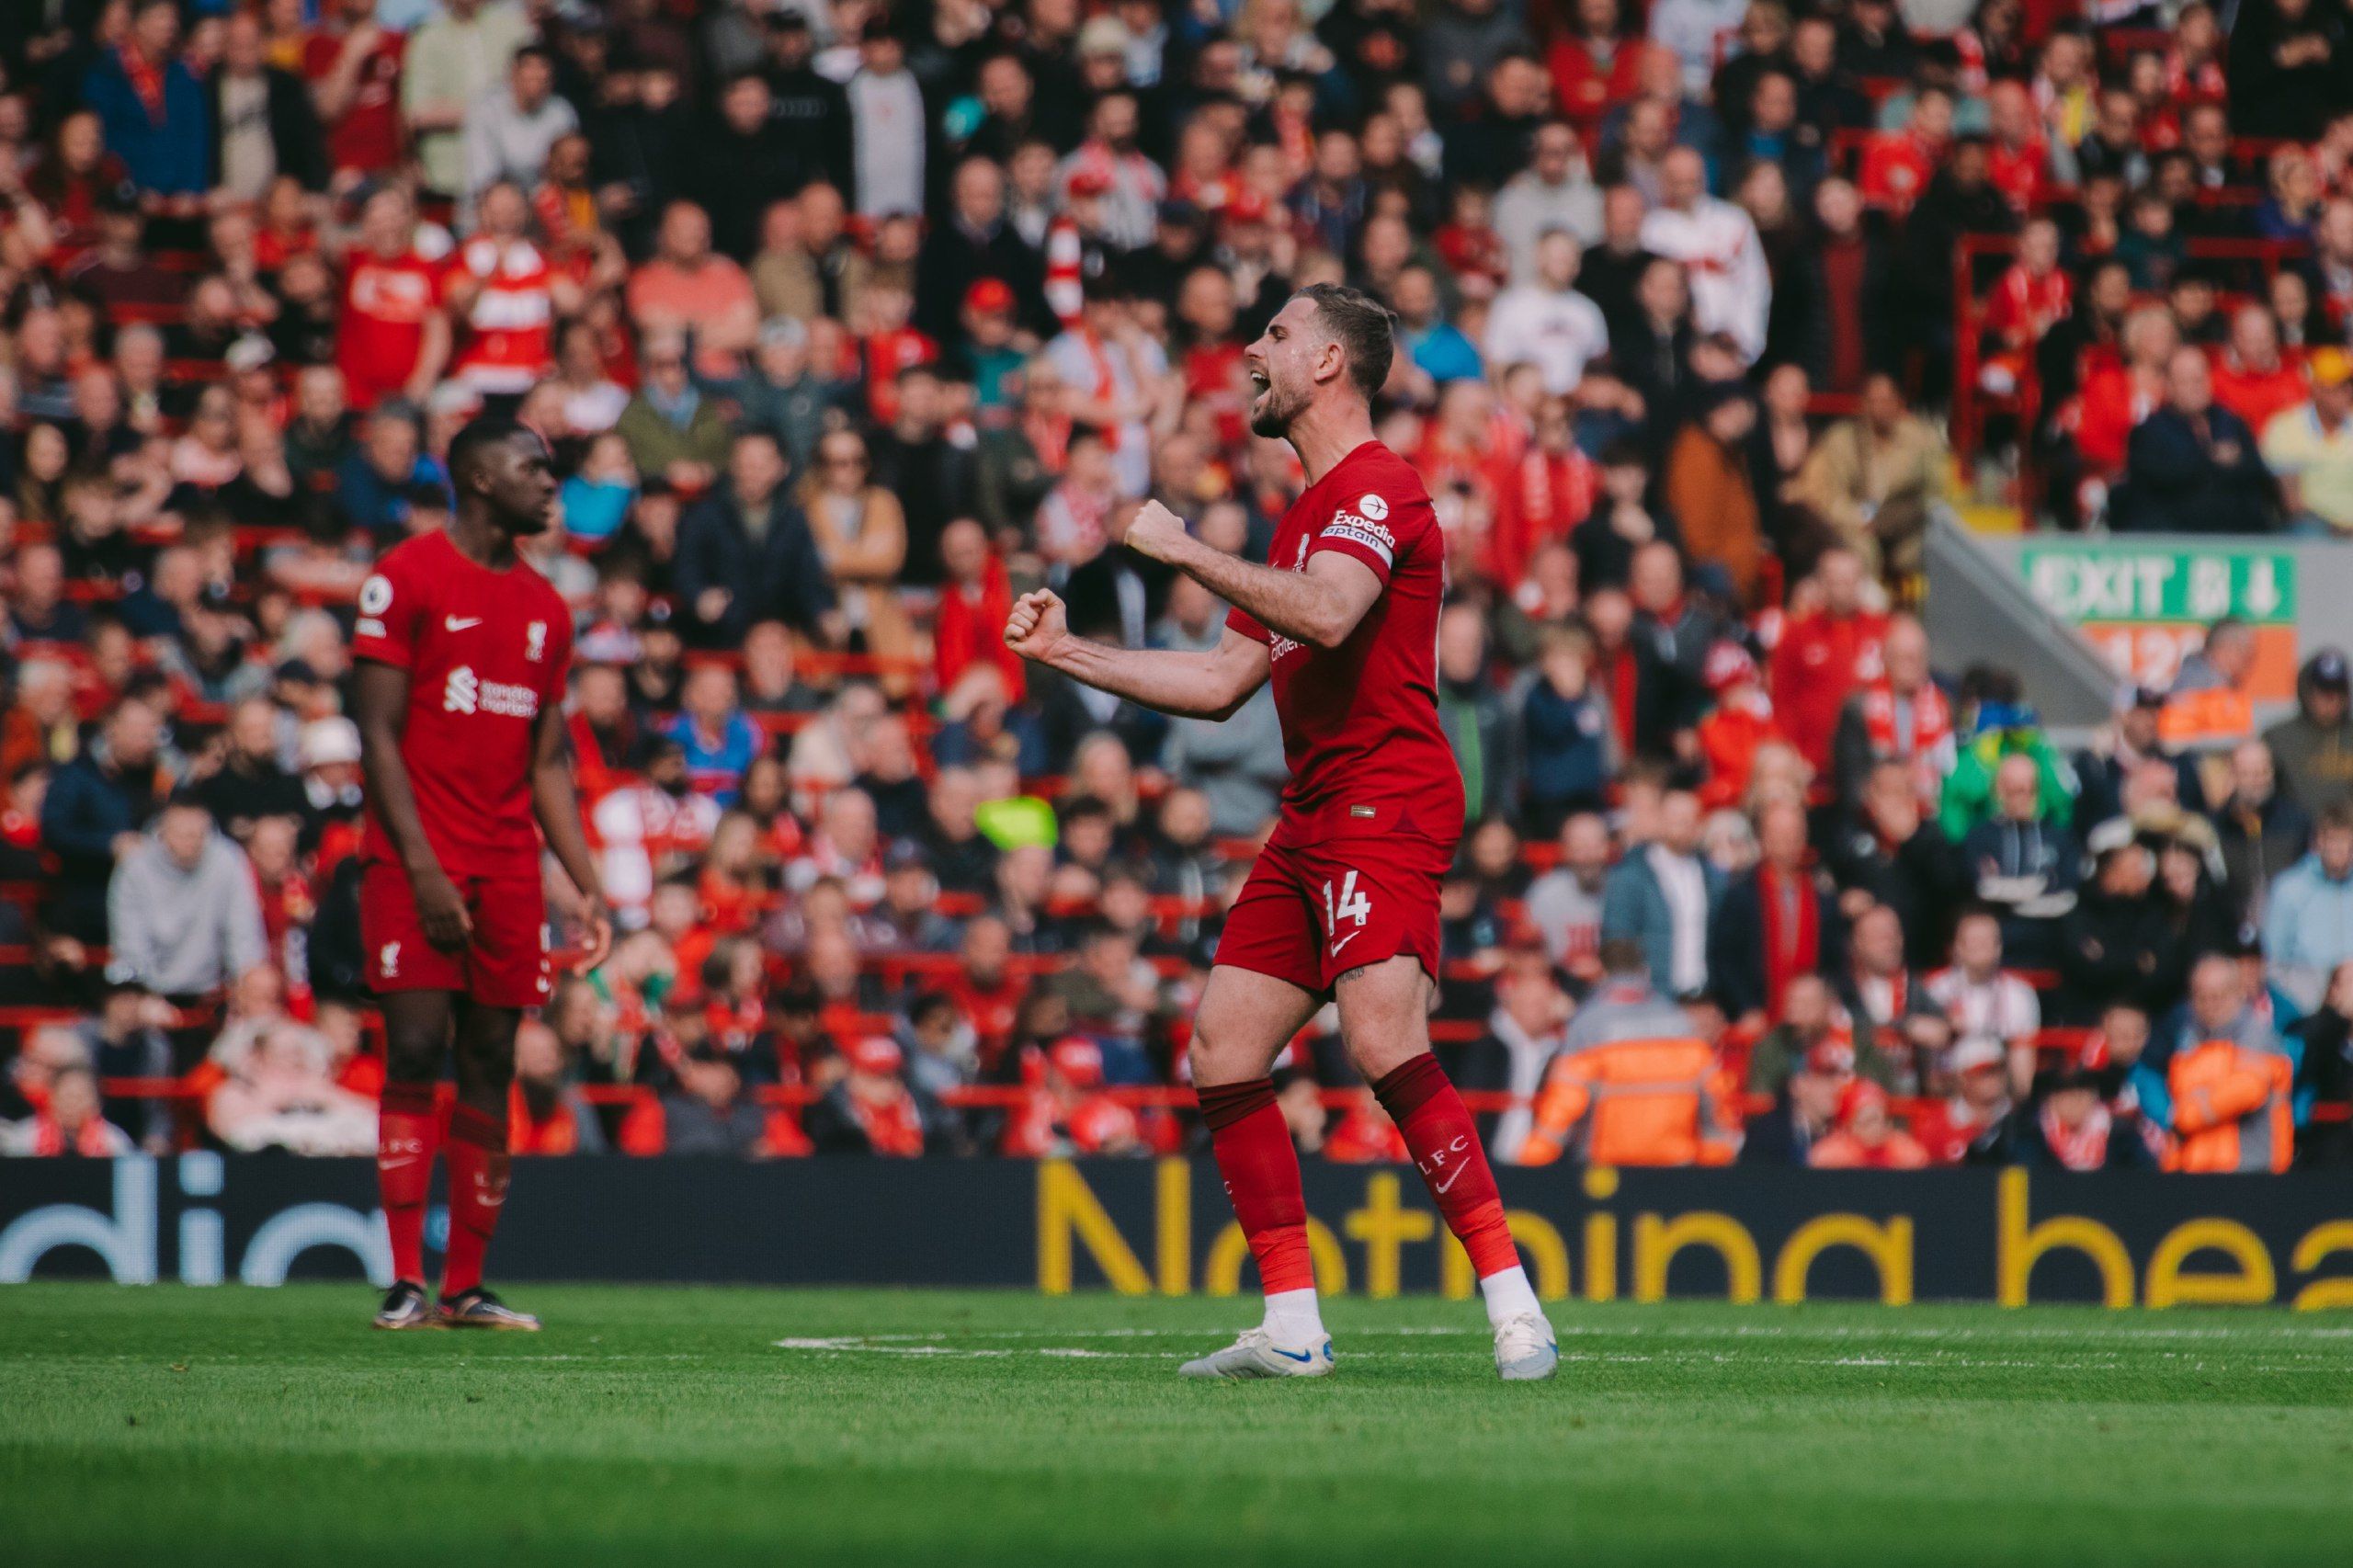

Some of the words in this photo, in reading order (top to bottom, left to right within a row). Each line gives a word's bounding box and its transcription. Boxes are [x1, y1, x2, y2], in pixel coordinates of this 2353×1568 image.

[1324, 528, 1379, 547] aptain
[1333, 510, 1395, 549] Expedia
[2029, 552, 2175, 617] EXIT
[2103, 627, 2206, 691] 12
[1323, 869, 1371, 937] 14
